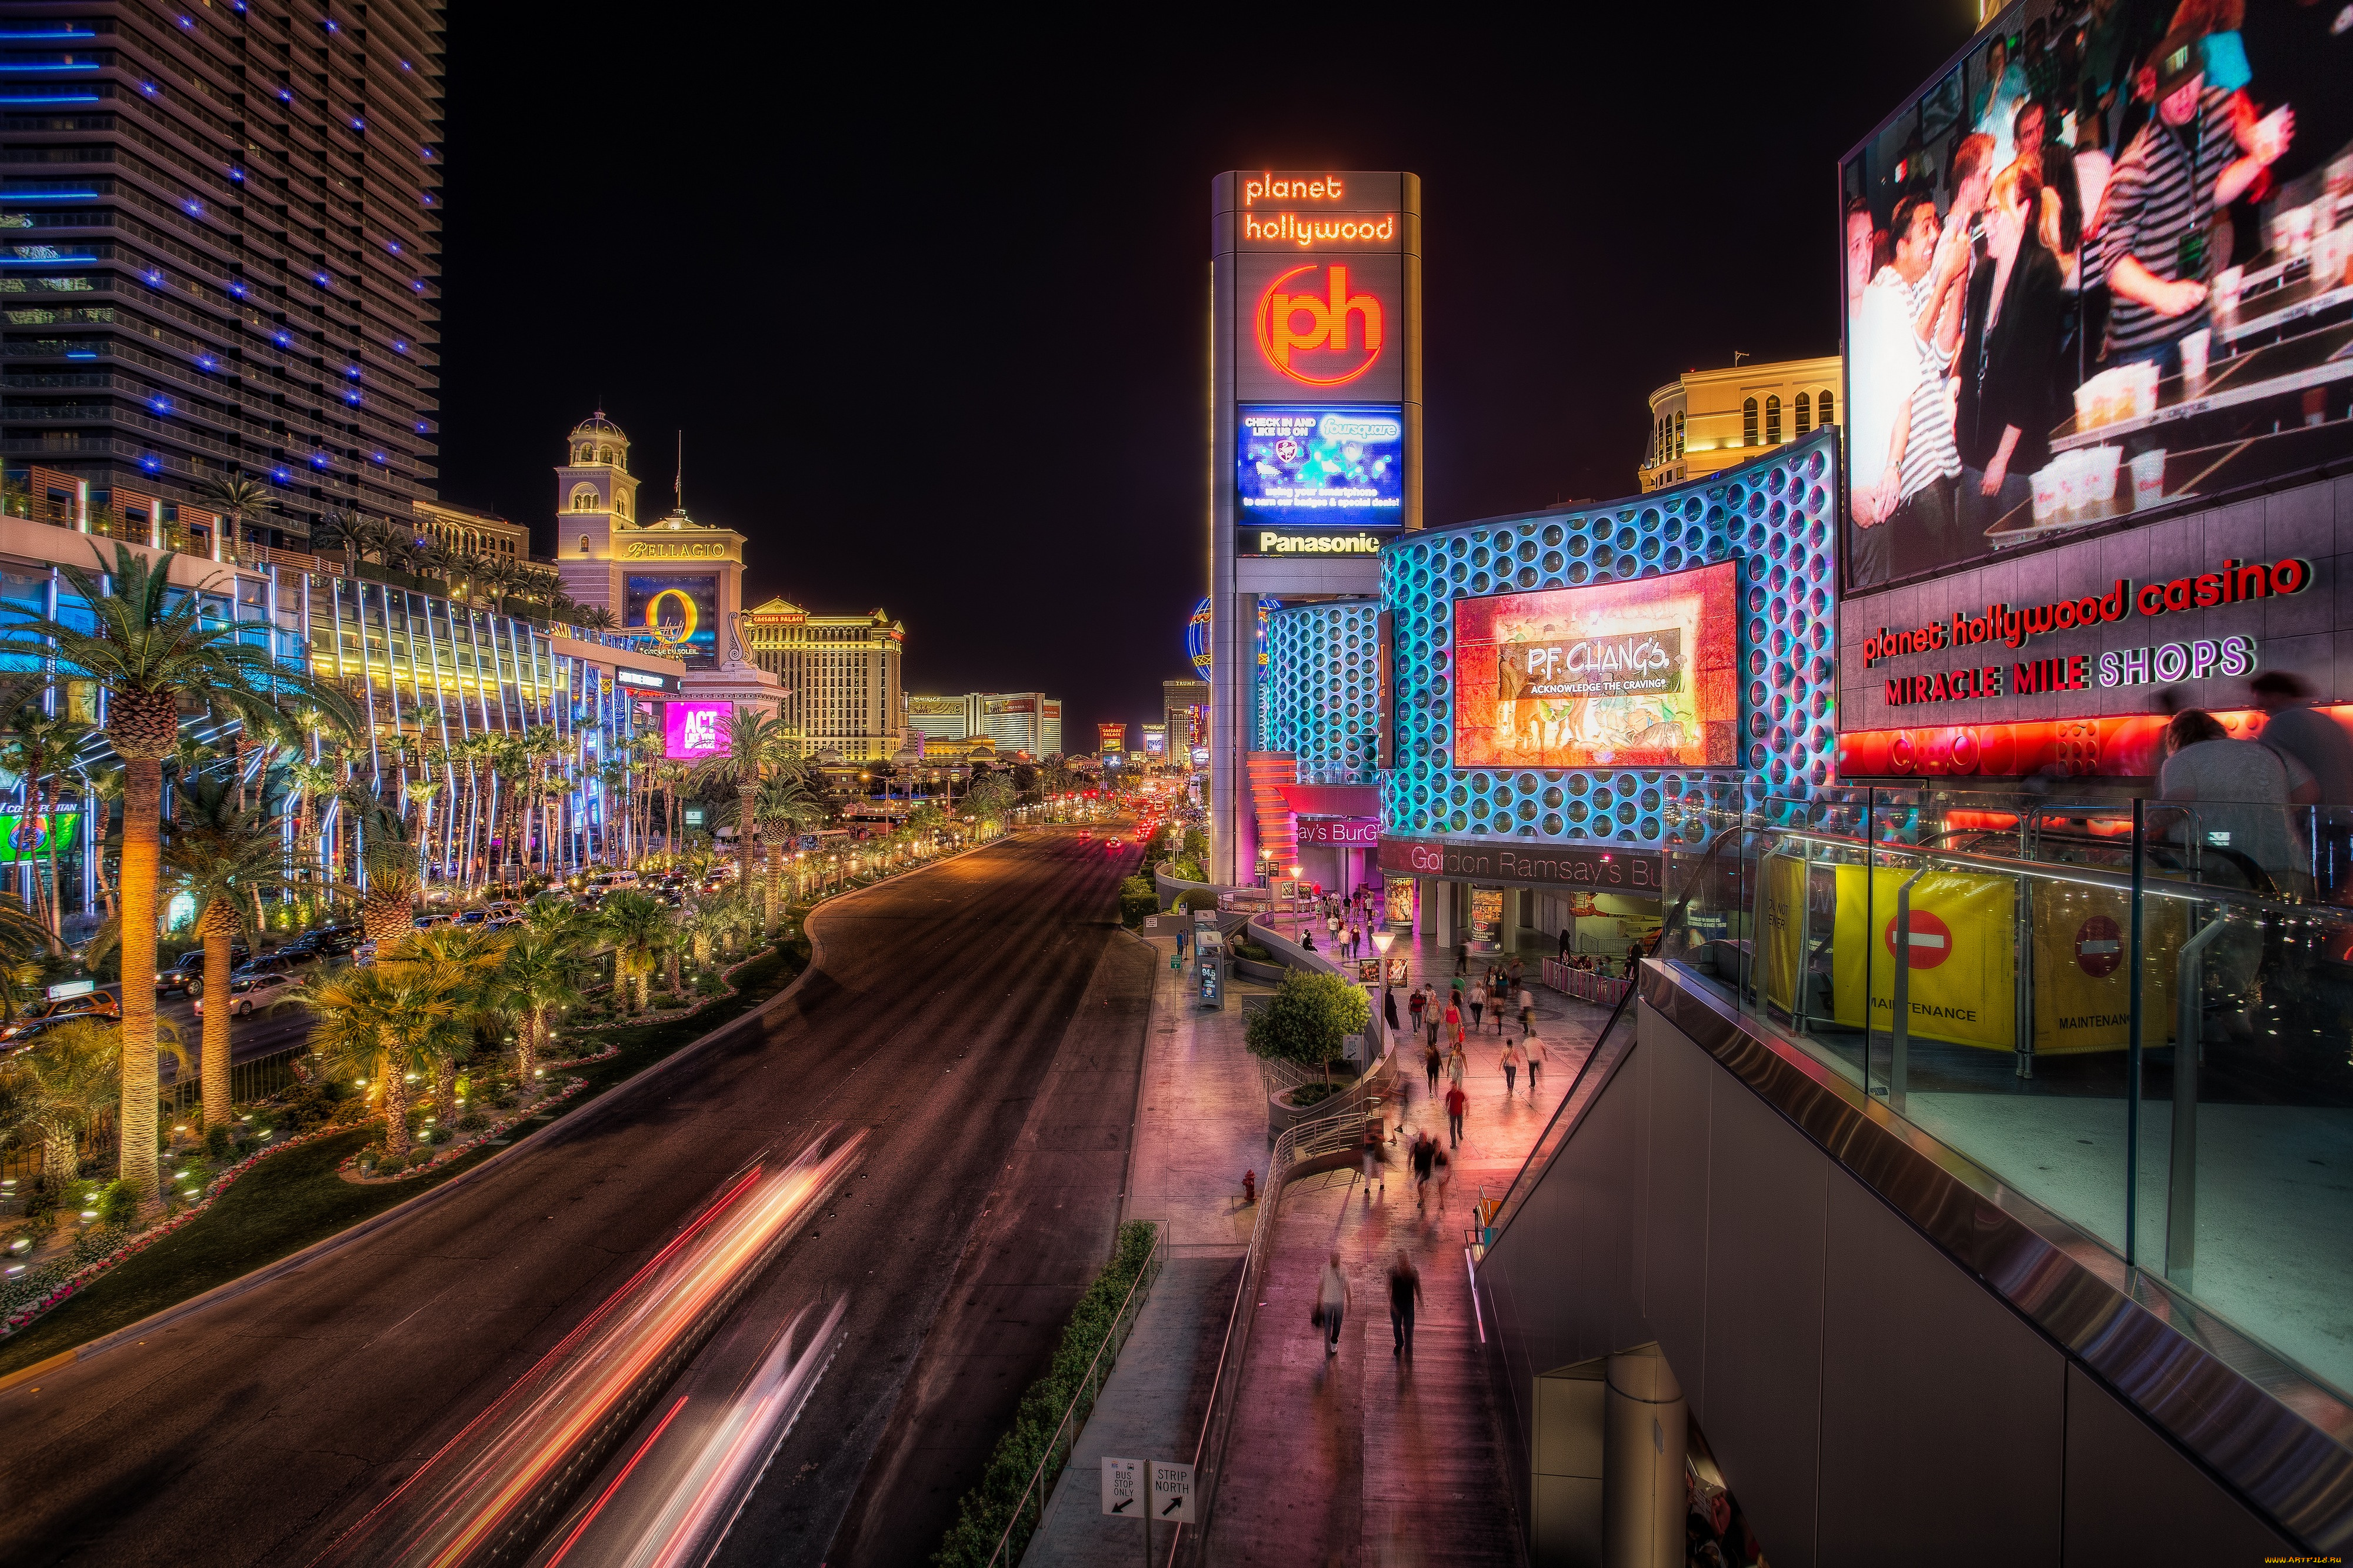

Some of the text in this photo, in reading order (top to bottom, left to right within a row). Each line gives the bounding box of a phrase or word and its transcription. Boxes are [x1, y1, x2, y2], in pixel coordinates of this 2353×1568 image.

[1245, 172, 1342, 206] planet
[1245, 213, 1394, 246] hollywood
[1245, 418, 1317, 428] CHECK IN AND
[1253, 427, 1308, 436] LIKE US ON
[1324, 418, 1397, 439] foursquare
[1295, 489, 1317, 498] your
[1319, 488, 1377, 498] smartphone
[622, 542, 724, 559] BELLAGIO
[1260, 532, 1380, 553] Panasonic
[1863, 559, 2305, 668] planet hollywood casino
[1528, 647, 1562, 680] P.F.
[1885, 636, 2251, 706] MIRACLE MILE SHOPS
[1531, 683, 1601, 694] ACKNOWLEDGE
[1603, 682, 1621, 690] THE
[685, 710, 717, 733] ACT
[1412, 846, 1488, 873] Gordon
[1499, 852, 1622, 885] Ramsay's
[1202, 968, 1216, 977] 94.5
[1871, 997, 1977, 1022] MAIENANCE
[1114, 1479, 1134, 1488] STOP
[1116, 1471, 1131, 1480] BUS
[1158, 1469, 1187, 1482] STRIP
[1114, 1488, 1134, 1497] ONLY
[1155, 1481, 1189, 1494] NORTH
